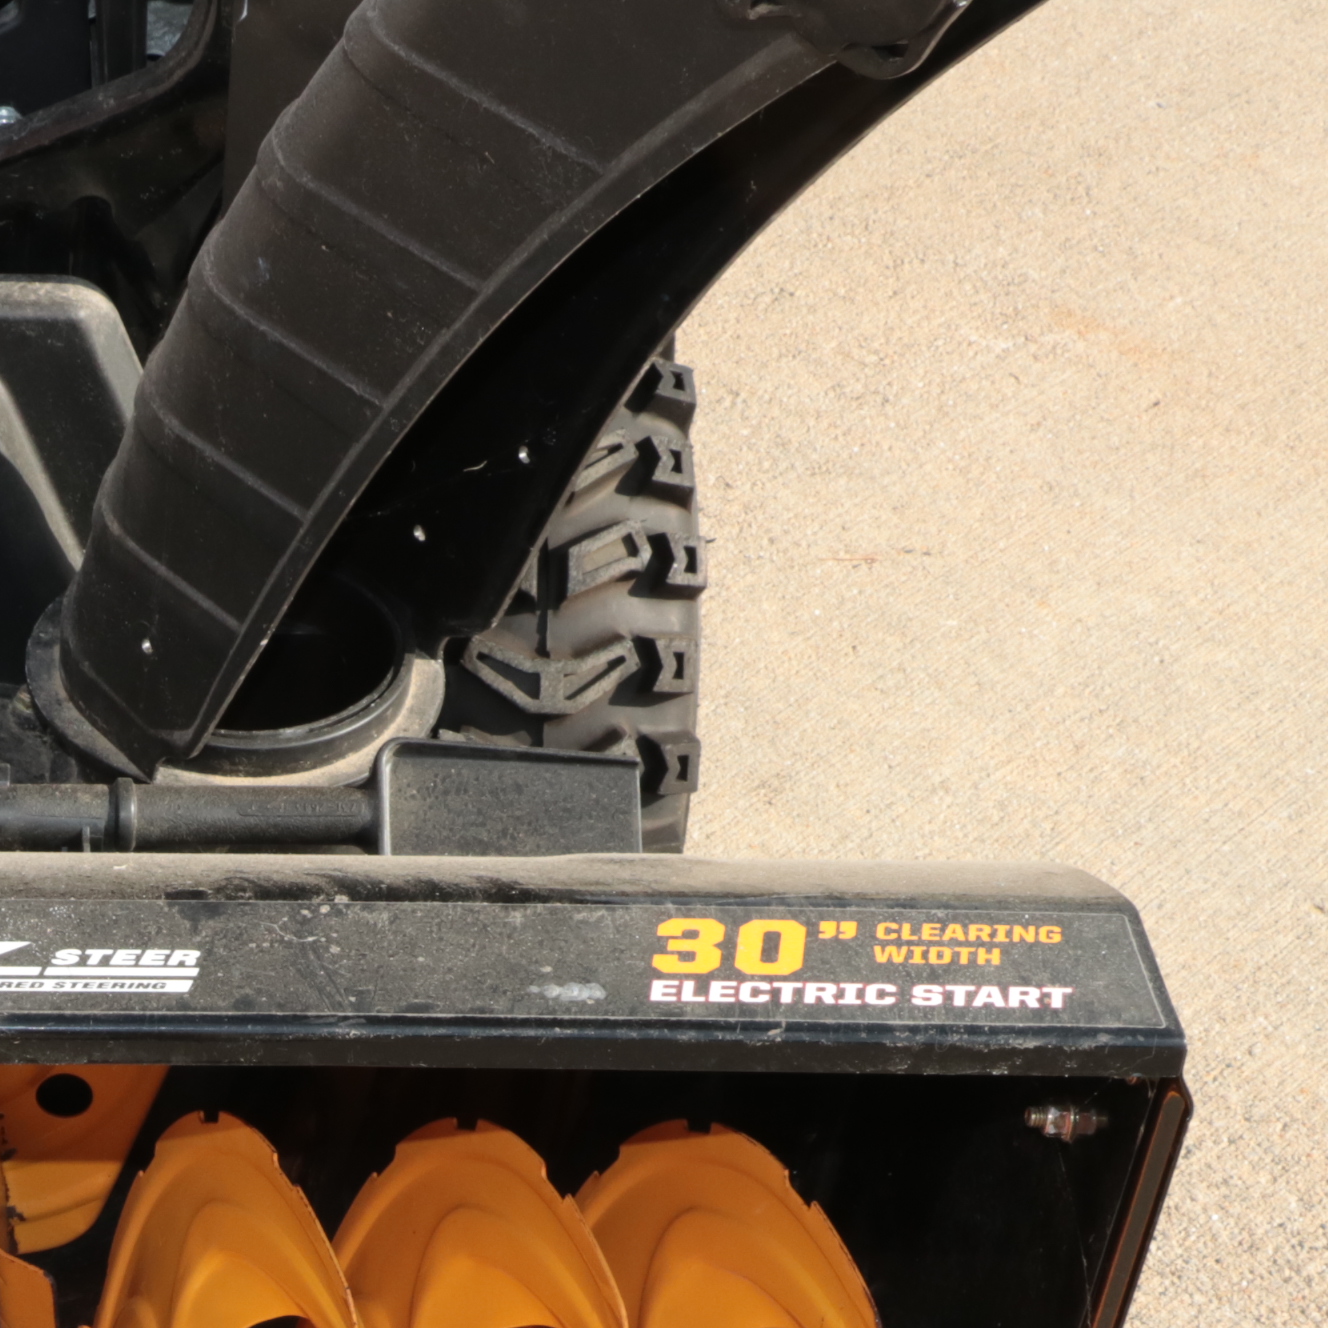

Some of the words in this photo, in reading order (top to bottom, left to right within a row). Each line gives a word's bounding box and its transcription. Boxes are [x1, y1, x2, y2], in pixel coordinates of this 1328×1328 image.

[875, 922, 1063, 943] CLEARING
[49, 949, 201, 966] STEER
[873, 945, 1001, 965] WIDTH
[51, 980, 167, 991] STEERING
[649, 979, 897, 1005] ELECTRIC
[911, 983, 1074, 1008] START
